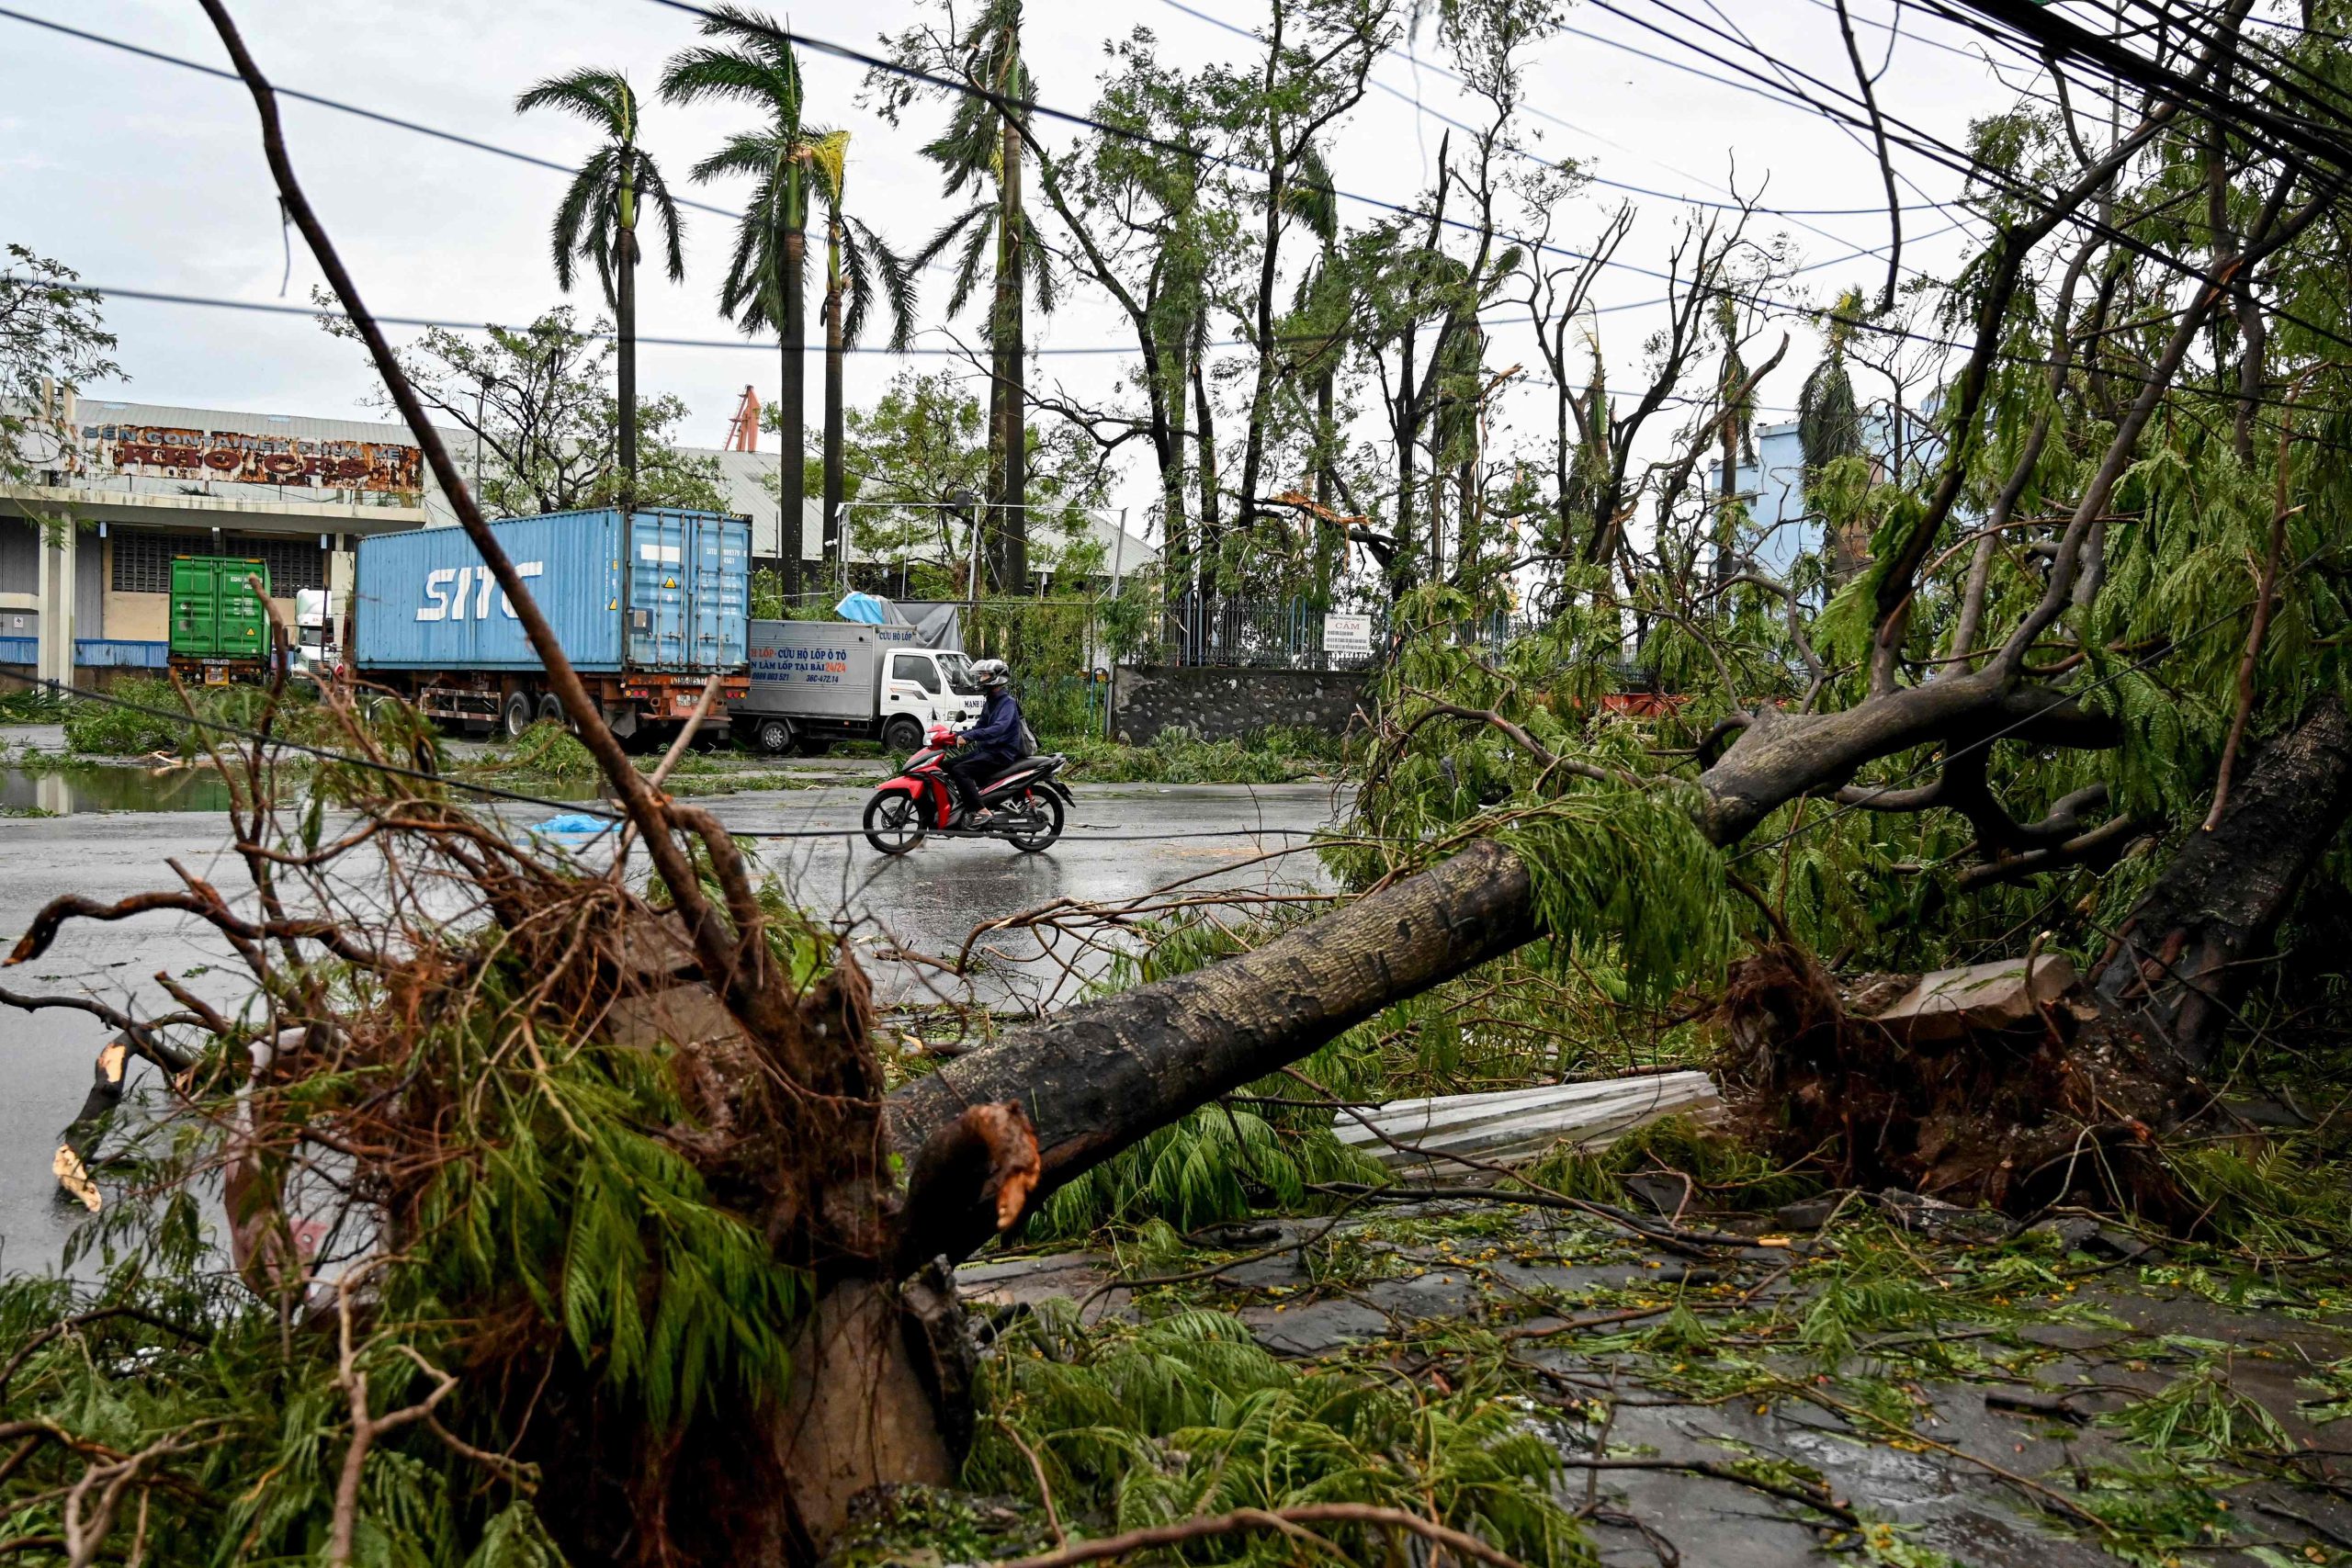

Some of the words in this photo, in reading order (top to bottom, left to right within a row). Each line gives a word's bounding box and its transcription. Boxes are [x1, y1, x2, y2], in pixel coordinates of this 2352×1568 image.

[146, 431, 288, 453] CONTAINER
[114, 444, 242, 470] KHO
[797, 648, 808, 661] HỘ
[810, 648, 825, 660] LỐP
[827, 649, 834, 660] Ô
[836, 649, 846, 660] TÔ
[777, 660, 793, 671] LỐP
[825, 661, 847, 672] 24/24
